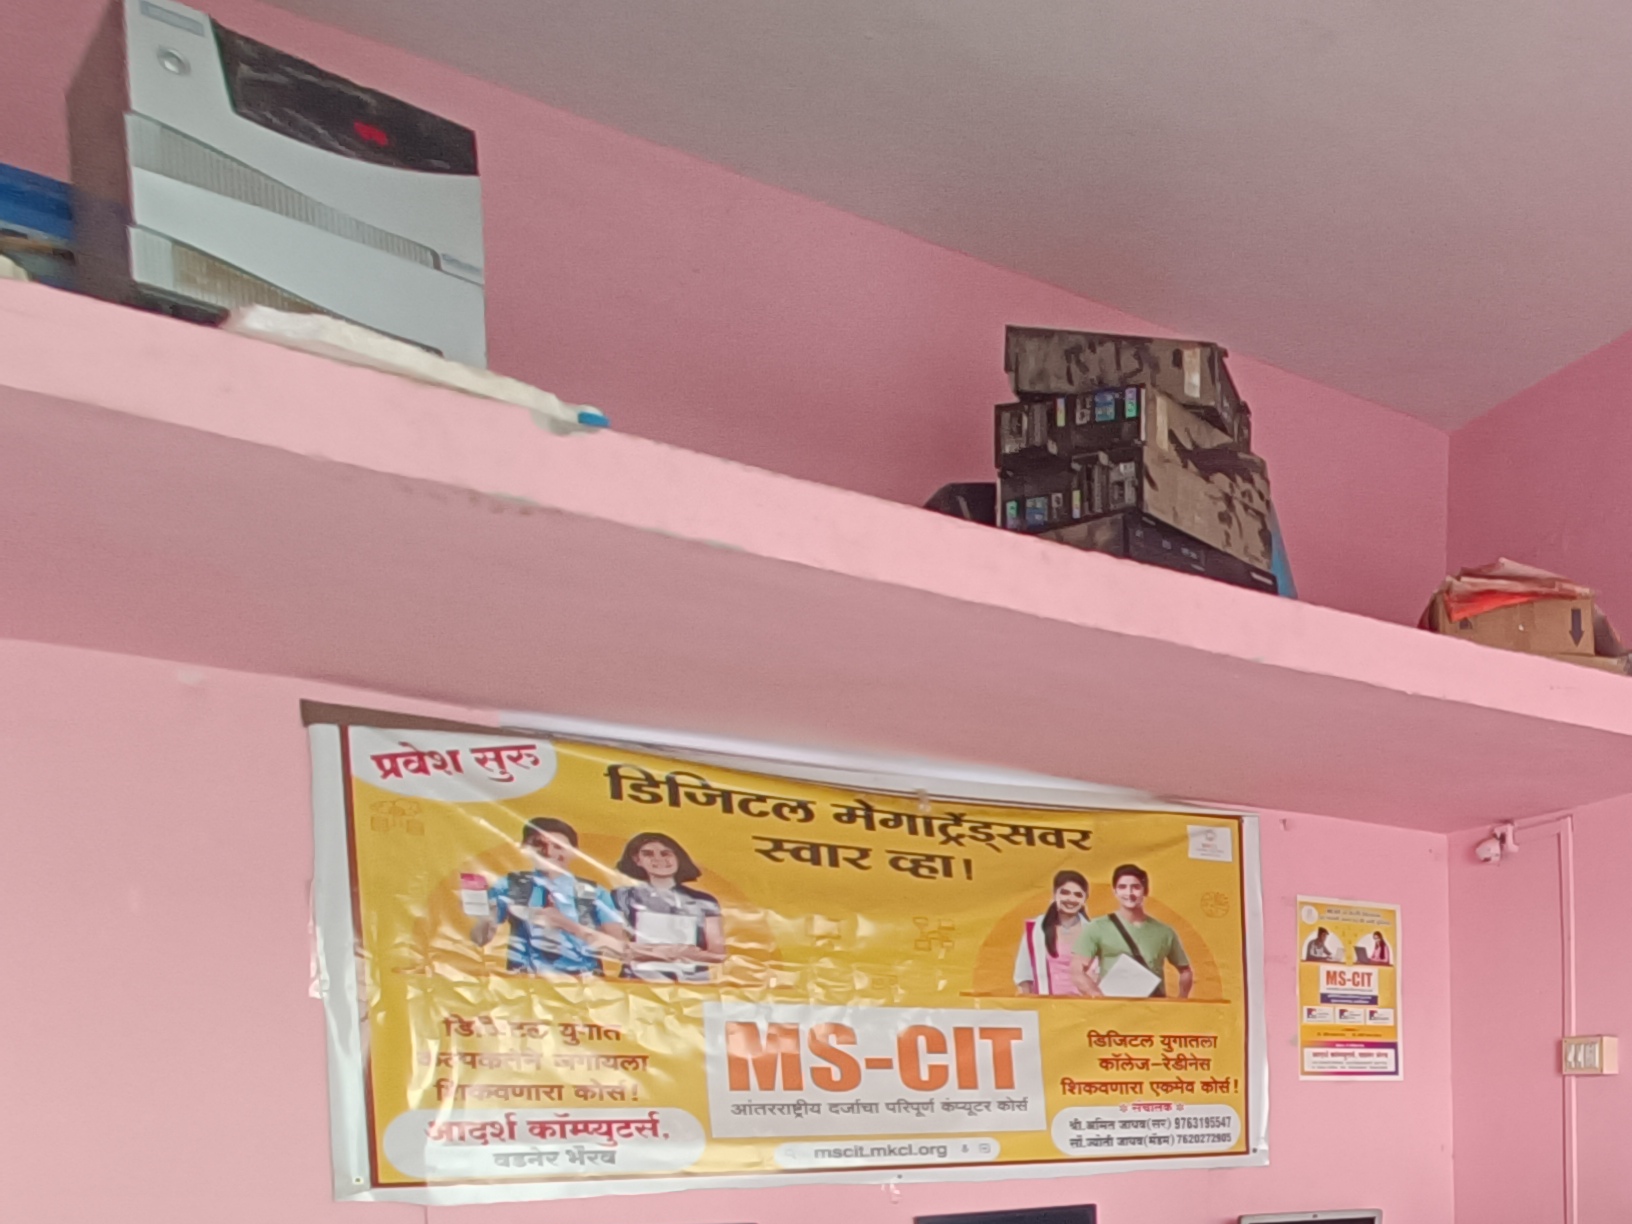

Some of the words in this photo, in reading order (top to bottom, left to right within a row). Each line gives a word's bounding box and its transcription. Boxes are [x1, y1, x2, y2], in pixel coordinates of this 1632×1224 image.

[371, 742, 462, 780] प्रवेश
[604, 764, 813, 821] डिजिटल
[751, 835, 872, 870] स्वार
[1326, 971, 1373, 987] MS-CIT
[1087, 1030, 1154, 1048] डिजिटल
[725, 1021, 1023, 1092] MS-CIT
[1061, 1077, 1144, 1095] शिकवणारा
[1150, 1077, 1194, 1096] एकमेव
[997, 1096, 1028, 1113] कोर्स
[425, 1113, 518, 1145] आदर्श
